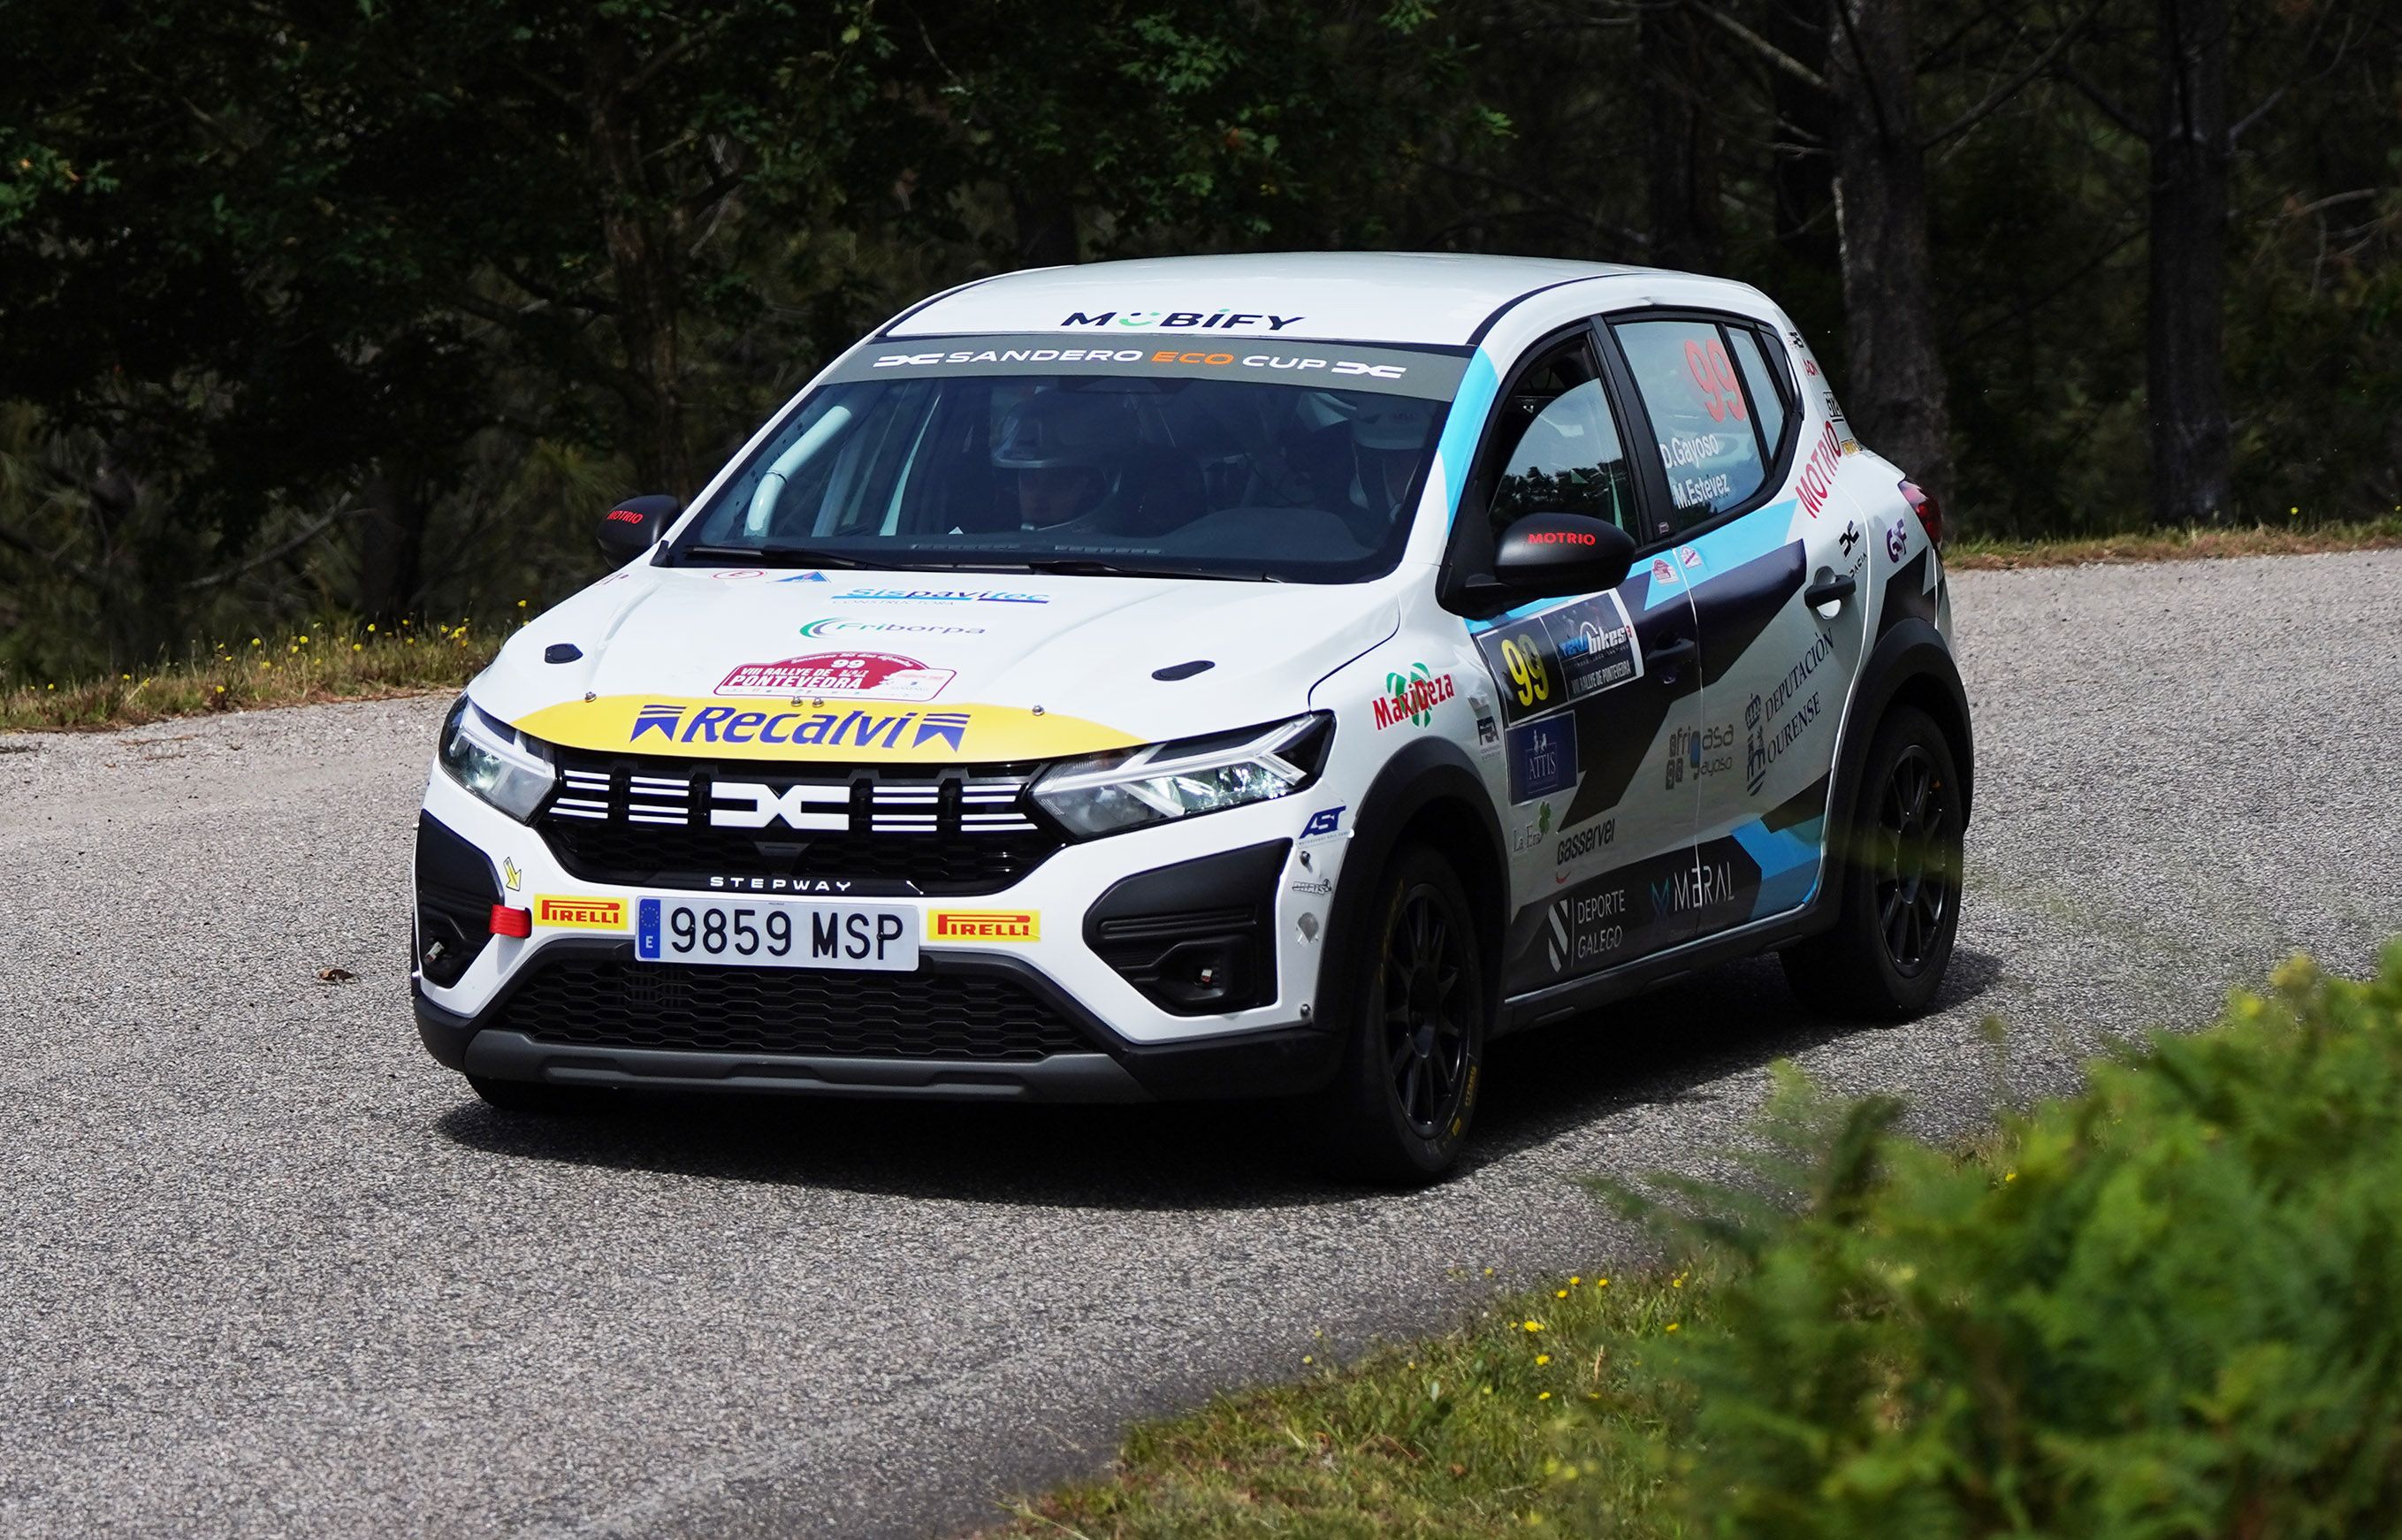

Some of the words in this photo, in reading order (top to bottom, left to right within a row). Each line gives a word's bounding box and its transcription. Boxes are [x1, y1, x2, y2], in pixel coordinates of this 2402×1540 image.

[945, 349, 1144, 363] SANDERO
[1151, 350, 1235, 365] ECO
[1242, 355, 1327, 370] CUP
[1684, 339, 1747, 423] 99
[1659, 433, 1720, 469] D.Gayoso
[1796, 420, 1842, 519] MOTRIO
[1527, 532, 1597, 545] MOTRIO
[836, 622, 987, 634] Friborpa
[763, 667, 811, 677] RALLYE
[813, 668, 831, 677] DE
[830, 659, 866, 668] 99
[1501, 634, 1550, 707] 99
[732, 675, 864, 690] PONTEVEDRA
[1372, 674, 1455, 730] MaxiDeza
[681, 706, 919, 749] Recalvi
[1767, 691, 1821, 764] OURENSE
[1529, 751, 1557, 781] ATTIS
[710, 876, 851, 891] STEPWAY
[542, 899, 621, 925] PIRELLI
[1578, 889, 1626, 924] DEPORTE
[671, 906, 791, 957] 9859
[812, 911, 904, 961] MSP
[938, 913, 1030, 936] PIRELLI
[646, 935, 653, 949] E
[1578, 925, 1623, 958] GALEGO
